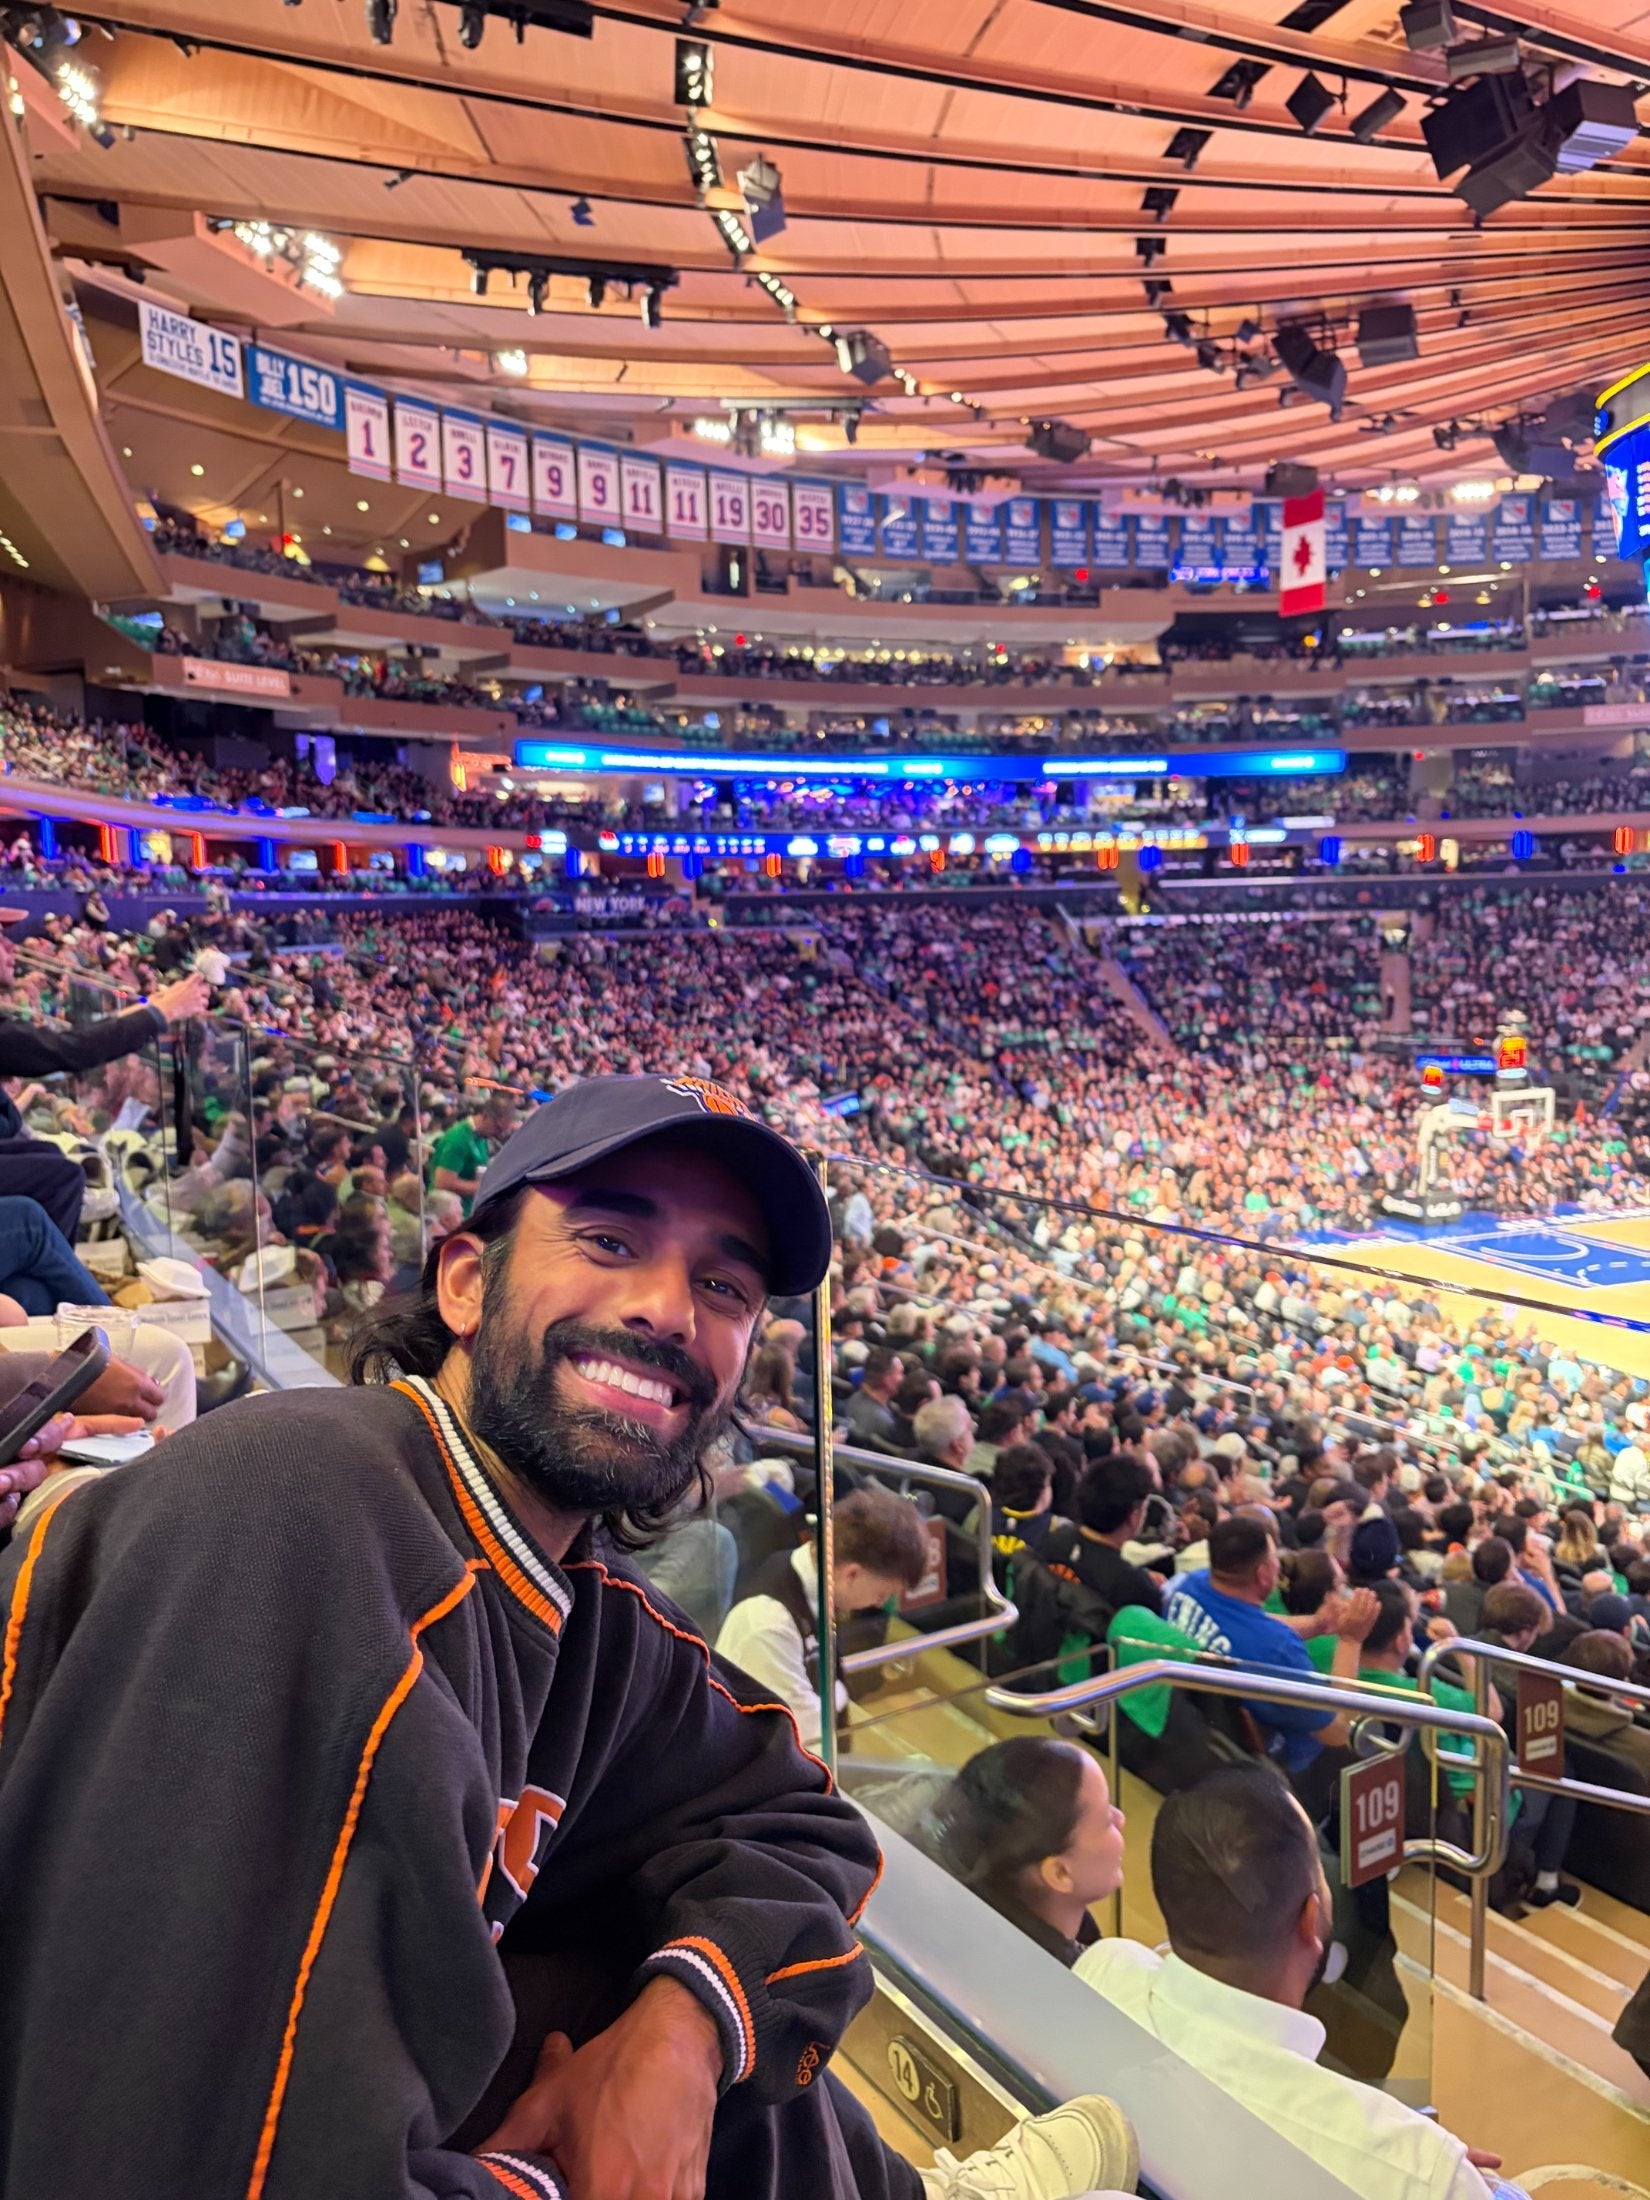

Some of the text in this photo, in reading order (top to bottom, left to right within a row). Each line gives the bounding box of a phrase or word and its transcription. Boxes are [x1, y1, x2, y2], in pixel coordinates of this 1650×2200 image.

[149, 308, 196, 343] HARRY
[147, 329, 203, 367] STYLES
[209, 333, 236, 378] 15
[287, 363, 337, 416] 150
[363, 419, 375, 457] 1
[410, 432, 428, 470] 2
[456, 444, 473, 480] 3
[500, 455, 515, 490] 7
[547, 465, 562, 498] 9
[592, 474, 607, 506] 9
[631, 481, 653, 514] 11
[675, 490, 698, 522] 11
[717, 495, 743, 527] 19
[756, 501, 784, 532] 30
[799, 505, 829, 536] 35
[1523, 1700, 1559, 1735] 109
[1356, 1780, 1400, 1833] 109
[894, 2050, 913, 2092] 14
